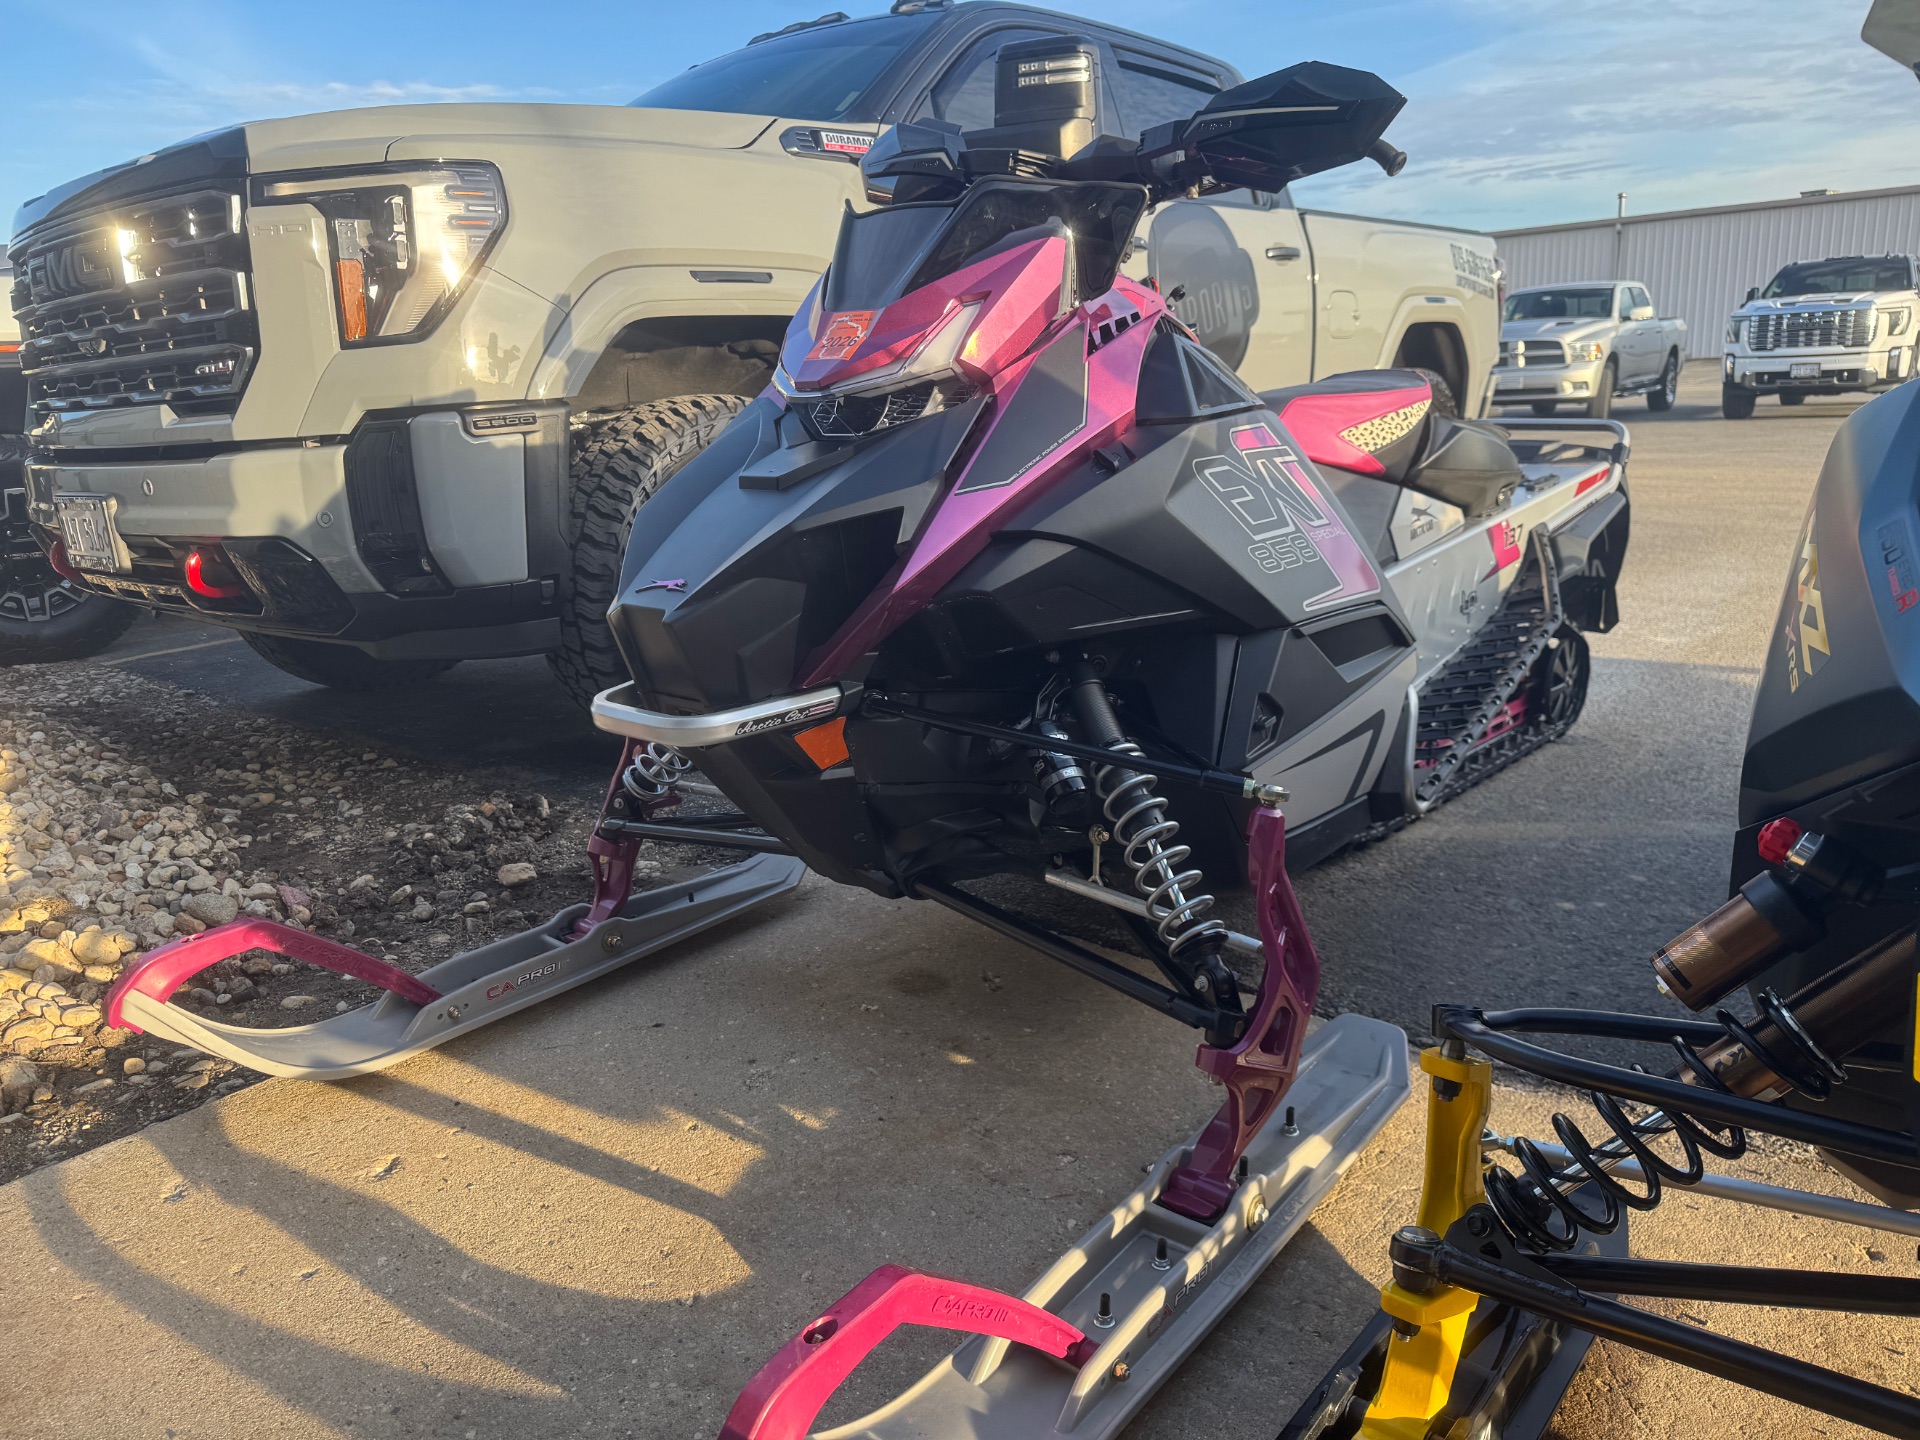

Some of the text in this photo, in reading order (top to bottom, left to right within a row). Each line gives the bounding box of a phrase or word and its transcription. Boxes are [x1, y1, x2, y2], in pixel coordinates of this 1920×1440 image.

[825, 133, 873, 147] DURAMAX
[27, 246, 115, 296] GMC
[821, 335, 860, 349] 2026
[1309, 526, 1346, 543] SPECIAL
[1503, 523, 1524, 549] 137
[1247, 532, 1320, 574] 858
[737, 709, 810, 736] Arctic Cat
[516, 962, 556, 984] PRO
